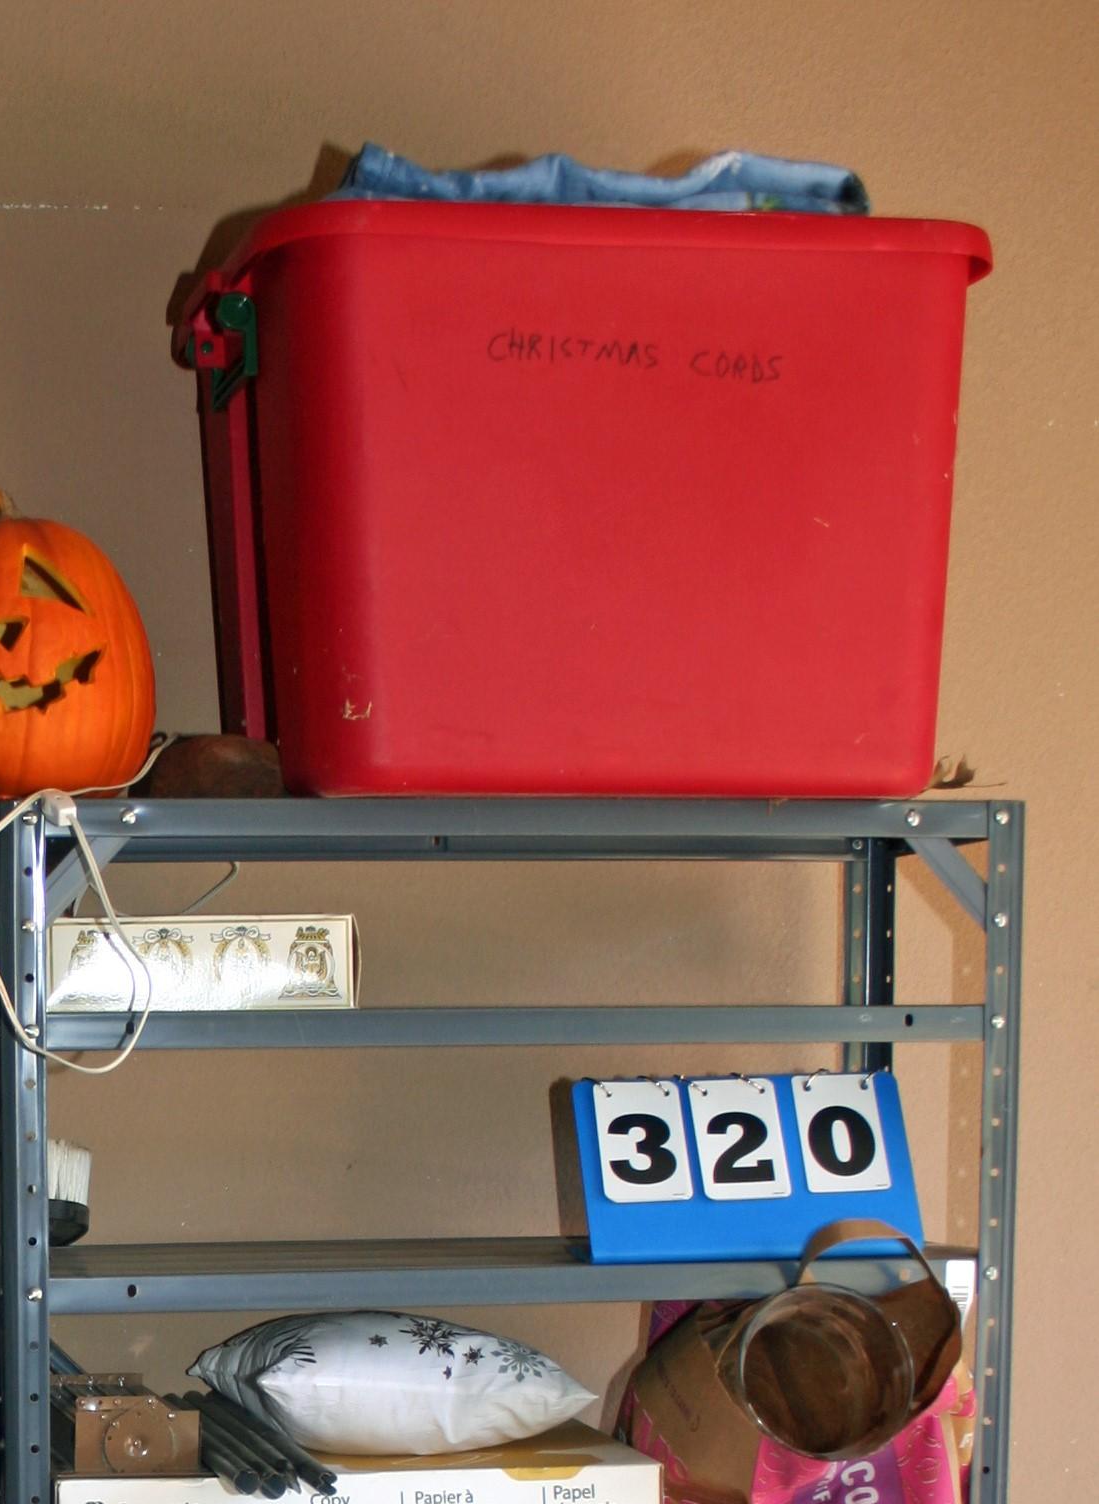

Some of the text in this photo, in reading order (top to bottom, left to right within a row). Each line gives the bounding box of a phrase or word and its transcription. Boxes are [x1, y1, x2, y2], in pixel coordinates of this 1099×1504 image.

[487, 328, 783, 384] CHRISTMAS CORDS
[465, 1489, 473, 1504] à
[553, 1484, 595, 1501] Papel
